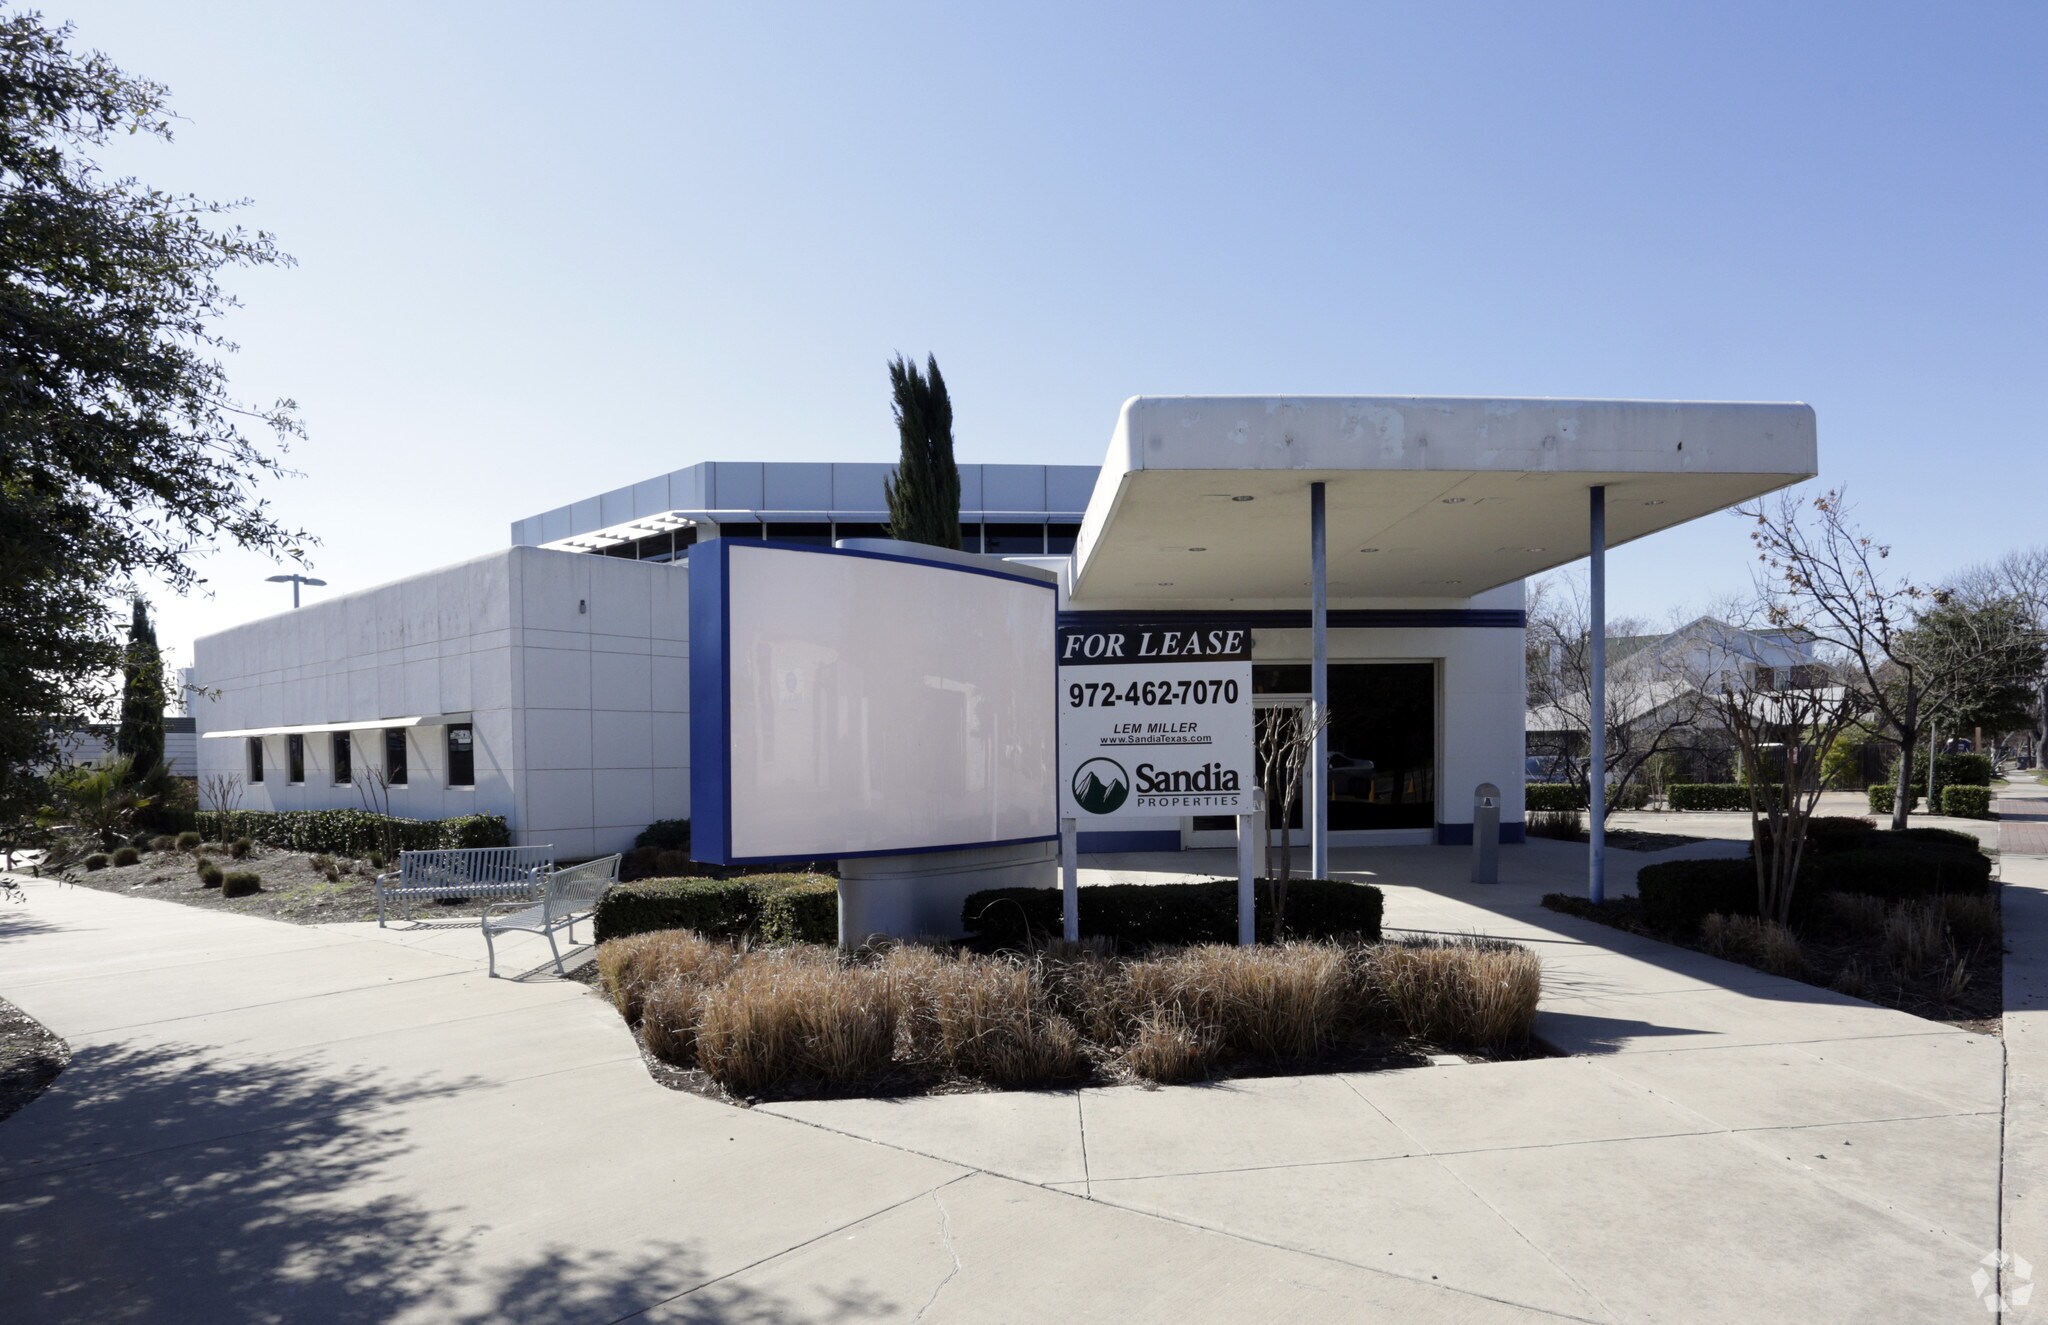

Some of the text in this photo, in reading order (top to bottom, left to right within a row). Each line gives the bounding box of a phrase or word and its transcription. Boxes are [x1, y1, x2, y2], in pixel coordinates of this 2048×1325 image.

[1062, 630, 1245, 659] FOR LEASE
[1069, 679, 1239, 708] 972-462-7070
[1113, 722, 1198, 734] LEM MILLER
[1100, 734, 1212, 744] www.SandiaTexas.com
[1136, 762, 1241, 794] Sandia
[1137, 796, 1239, 807] PROPERTIES
